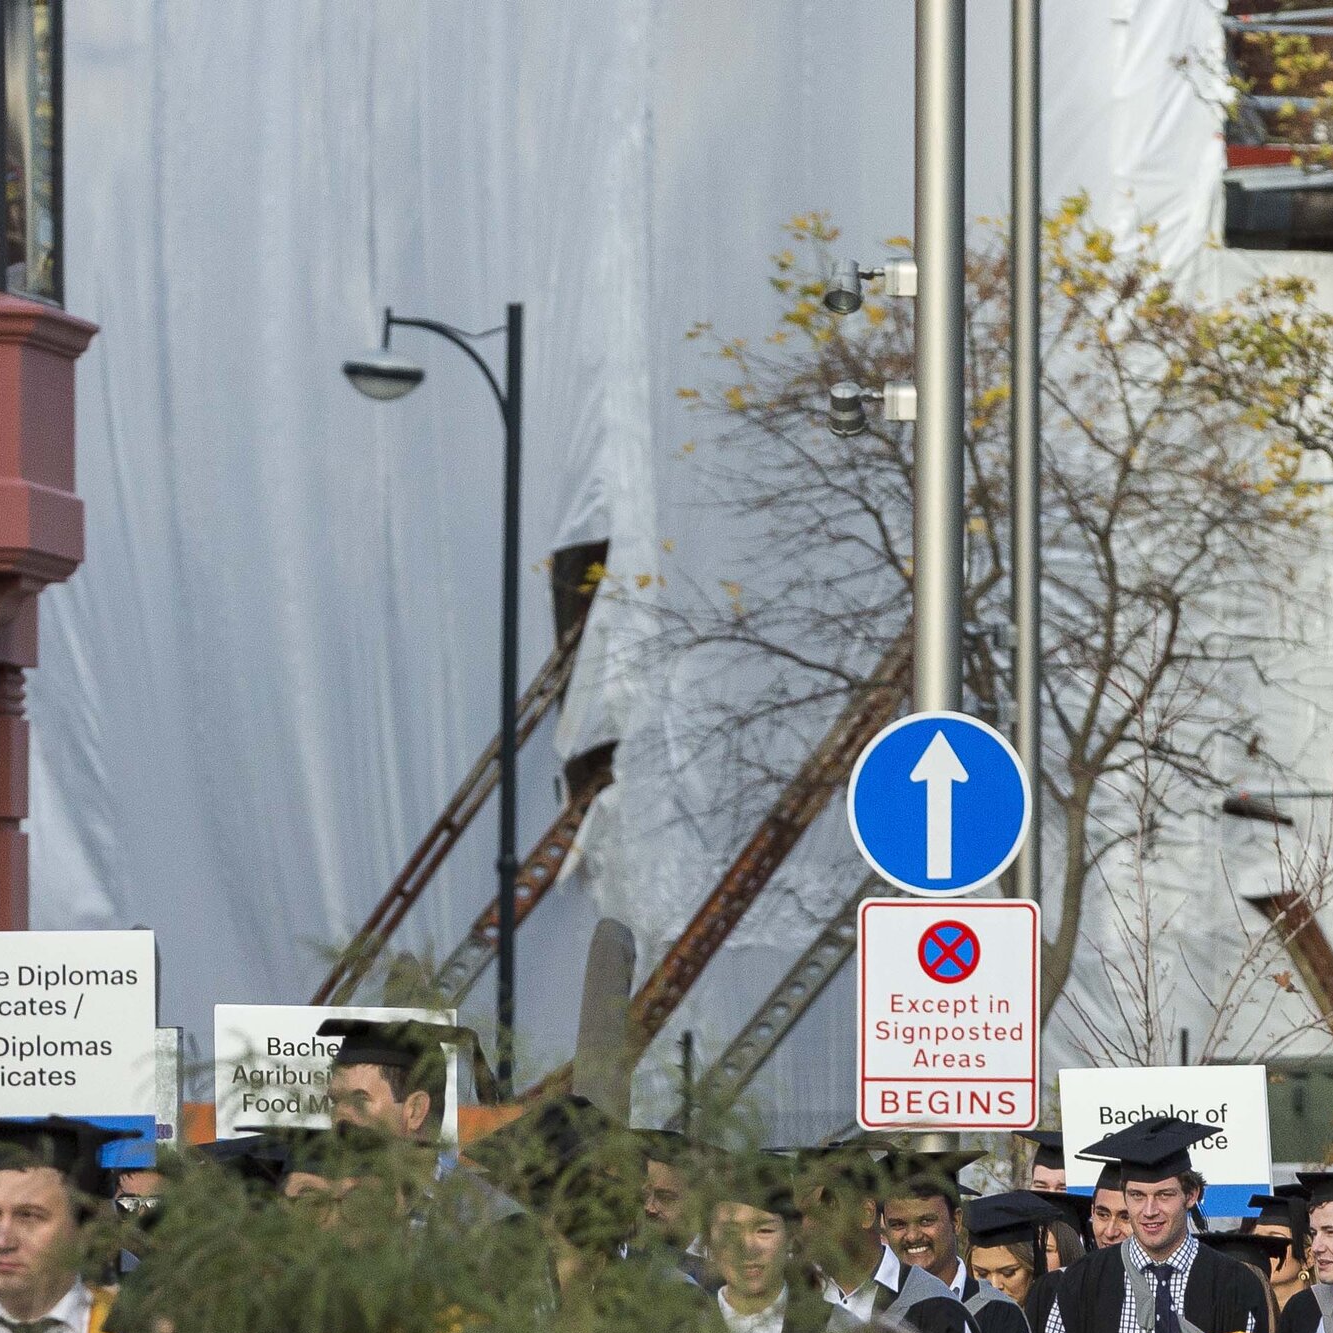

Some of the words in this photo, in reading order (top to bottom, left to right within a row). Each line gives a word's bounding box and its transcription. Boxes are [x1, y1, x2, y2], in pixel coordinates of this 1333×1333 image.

[18, 964, 138, 990] Diplomas
[890, 994, 979, 1018] Except
[989, 995, 1010, 1013] in
[875, 1021, 1024, 1045] Signposted
[913, 1049, 987, 1068] Areas
[242, 1093, 301, 1114] Food
[880, 1090, 1016, 1115] BEGINS
[1205, 1103, 1228, 1123] of
